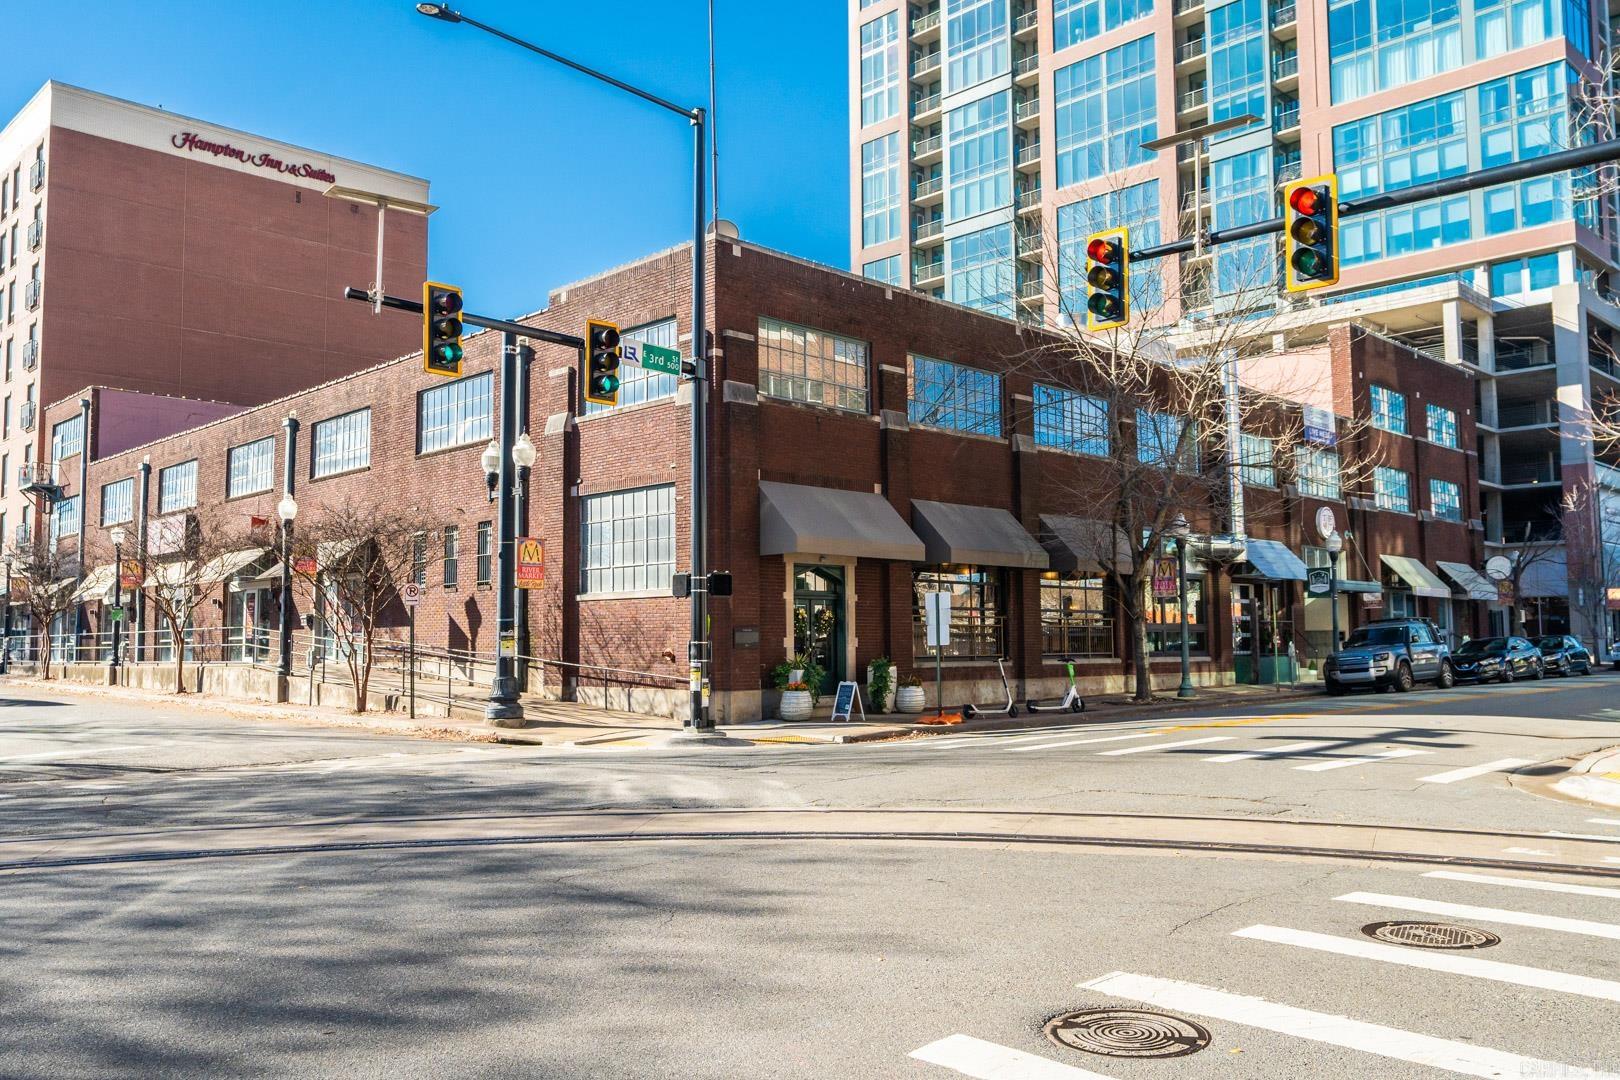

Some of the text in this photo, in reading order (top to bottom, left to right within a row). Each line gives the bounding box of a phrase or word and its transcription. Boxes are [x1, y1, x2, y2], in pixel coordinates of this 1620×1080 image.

[172, 132, 336, 184] Hampton Inn & Suites
[643, 350, 679, 366] E 3rd St
[667, 361, 680, 371] 500
[522, 543, 540, 562] M
[521, 566, 541, 574] RIVER
